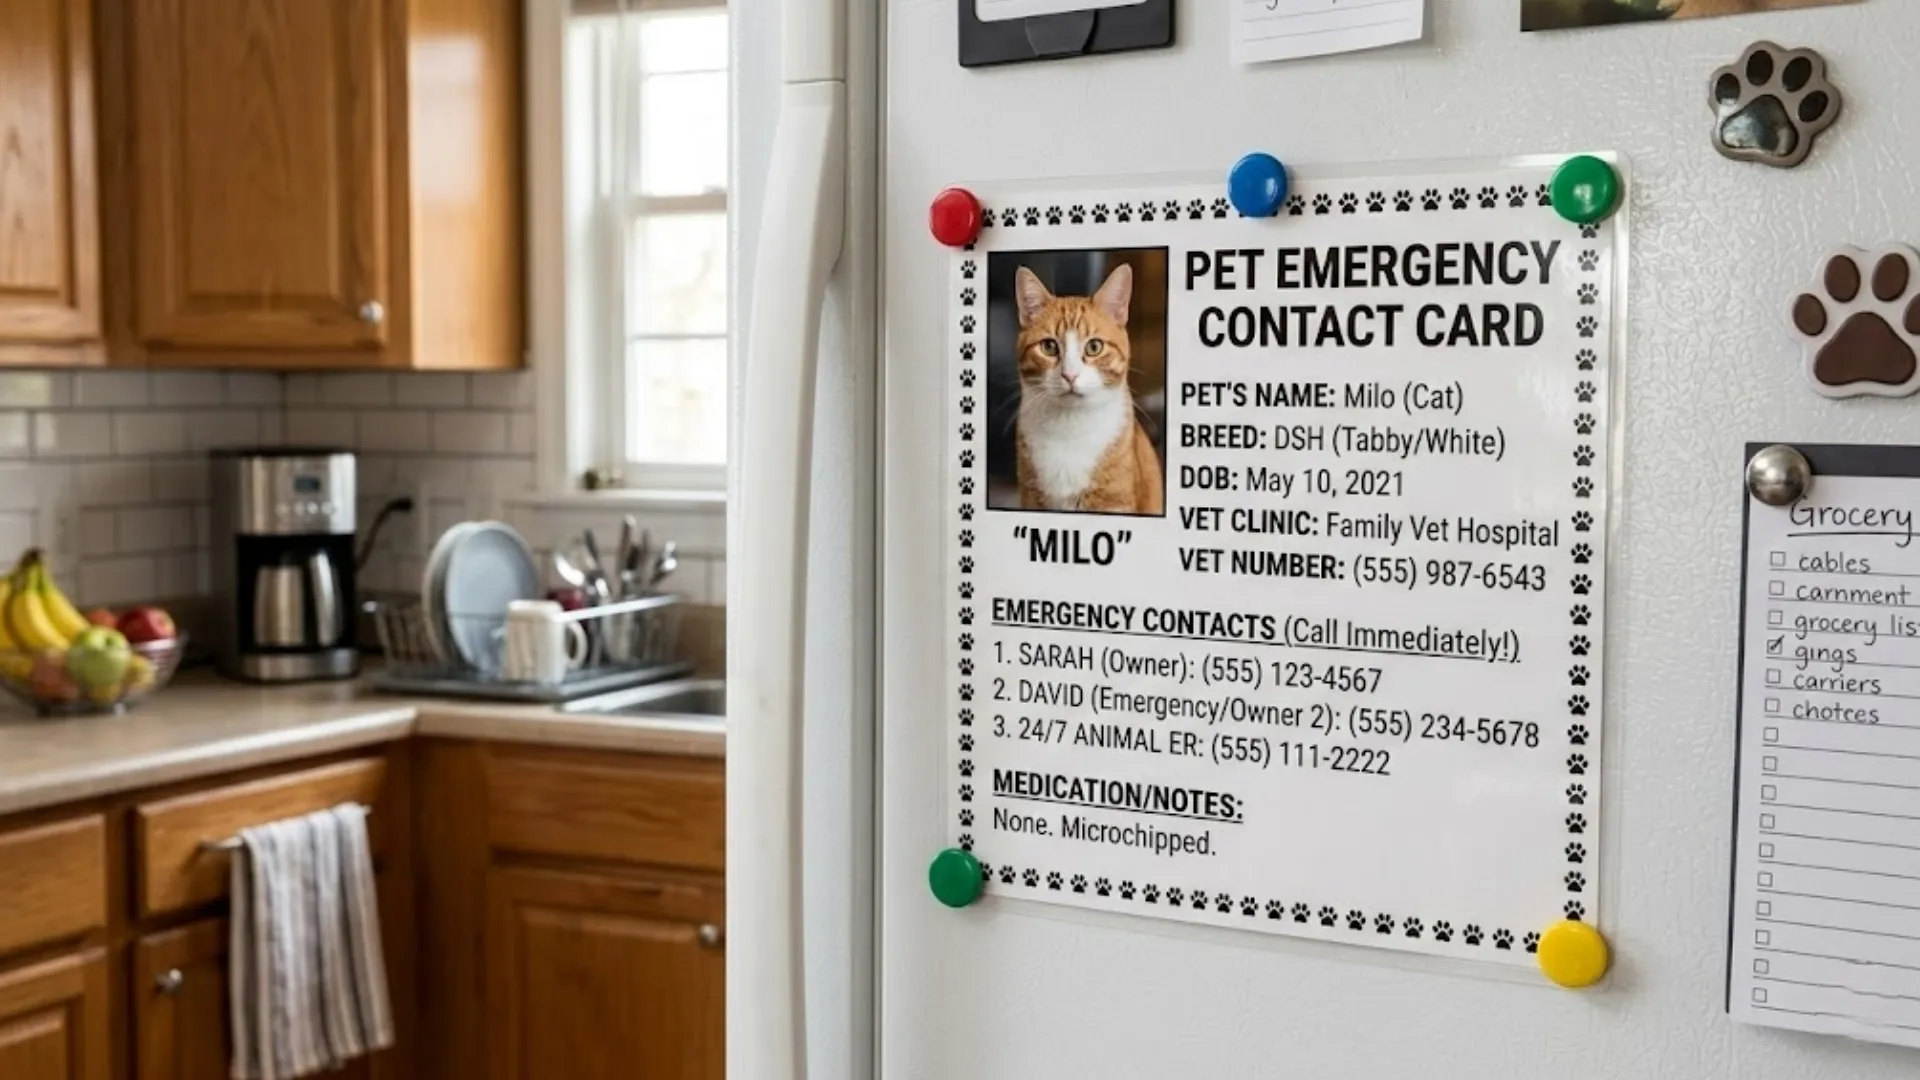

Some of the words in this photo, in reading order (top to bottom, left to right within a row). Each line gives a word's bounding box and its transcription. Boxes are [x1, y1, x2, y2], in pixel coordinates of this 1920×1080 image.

[1185, 249, 1264, 291] PET
[1277, 240, 1561, 289] EMERGENCY
[1199, 304, 1404, 348] CONTACT
[1416, 303, 1544, 347] CARD
[1181, 381, 1247, 407] PET'S
[1255, 383, 1335, 408] NAME:
[1344, 382, 1395, 409] Milo
[1403, 381, 1463, 416] (Cat)
[1181, 423, 1266, 450] BREED:
[1275, 425, 1324, 451] DSH
[1333, 424, 1505, 462] (Tabby/White)
[1181, 465, 1238, 491] DOB:
[1247, 467, 1294, 498] May
[1304, 469, 1337, 498] 10,
[1346, 469, 1402, 496] 2021
[1179, 506, 1225, 533] VET
[1231, 508, 1318, 536] CLINIC:
[1327, 511, 1402, 546] Family
[1409, 515, 1449, 543] Vet
[1458, 517, 1558, 551] Hospital
[1789, 499, 1913, 548] Grocery
[1179, 547, 1225, 573] VET
[1231, 550, 1345, 580] NUMBER:
[1354, 554, 1417, 590] (555)
[1426, 559, 1546, 592] 987-6543
[1799, 551, 1871, 574] cables
[992, 597, 1136, 630] EMERGENCY
[1143, 608, 1276, 640] CONTACTS
[1284, 615, 1338, 648] (Call
[1347, 621, 1520, 663] Immediately!)
[1795, 614, 1877, 646] grocery
[1890, 614, 1920, 636] lis
[993, 641, 1011, 664] 1.
[1019, 643, 1093, 671] SARAH
[1101, 647, 1194, 684] (Owner):
[1202, 653, 1262, 690] (555)
[1271, 662, 1382, 693] 123-4567
[993, 677, 1011, 701] 2.
[1020, 679, 1083, 707] DAVID
[1091, 684, 1303, 731] (Emergency/Owner
[1310, 704, 1340, 736] 2):
[1349, 706, 1412, 743] (555)
[1421, 713, 1539, 749] 234-5678
[994, 714, 1011, 738] 3.
[1019, 717, 1067, 743] 24/7
[1074, 722, 1162, 753] ANIMAL
[1170, 731, 1203, 757] ER:
[1212, 733, 1270, 769] (555)
[1280, 742, 1390, 776] 111-2222
[993, 768, 1243, 820] MEDICATION/NOTES:
[994, 807, 1053, 837] None.
[1062, 815, 1216, 856] Microchipped.
